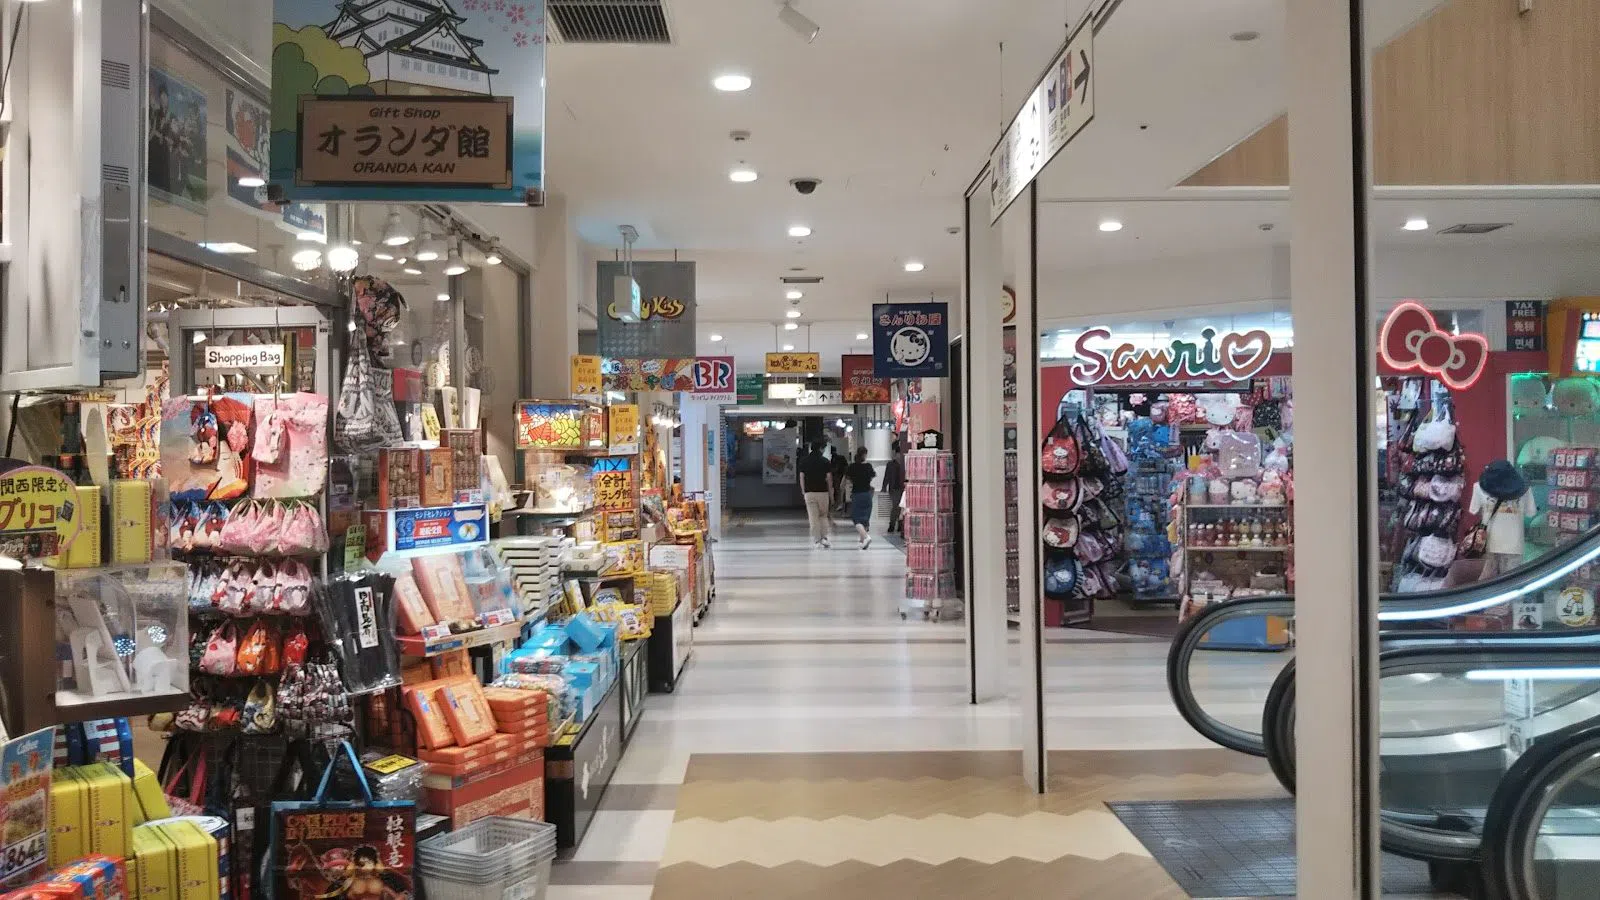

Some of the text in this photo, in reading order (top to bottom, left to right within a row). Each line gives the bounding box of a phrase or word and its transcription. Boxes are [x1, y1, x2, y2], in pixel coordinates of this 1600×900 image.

[369, 107, 441, 119] Gift Shop
[316, 124, 490, 158] オランダ館
[352, 162, 456, 174] ORANDA KAN
[652, 295, 685, 318] Kiss
[1511, 309, 1536, 317] FREE
[208, 350, 280, 366] Shopping Bag
[1069, 326, 1273, 386] Sanrio
[693, 360, 731, 388] BR
[0, 496, 55, 530] グリコ
